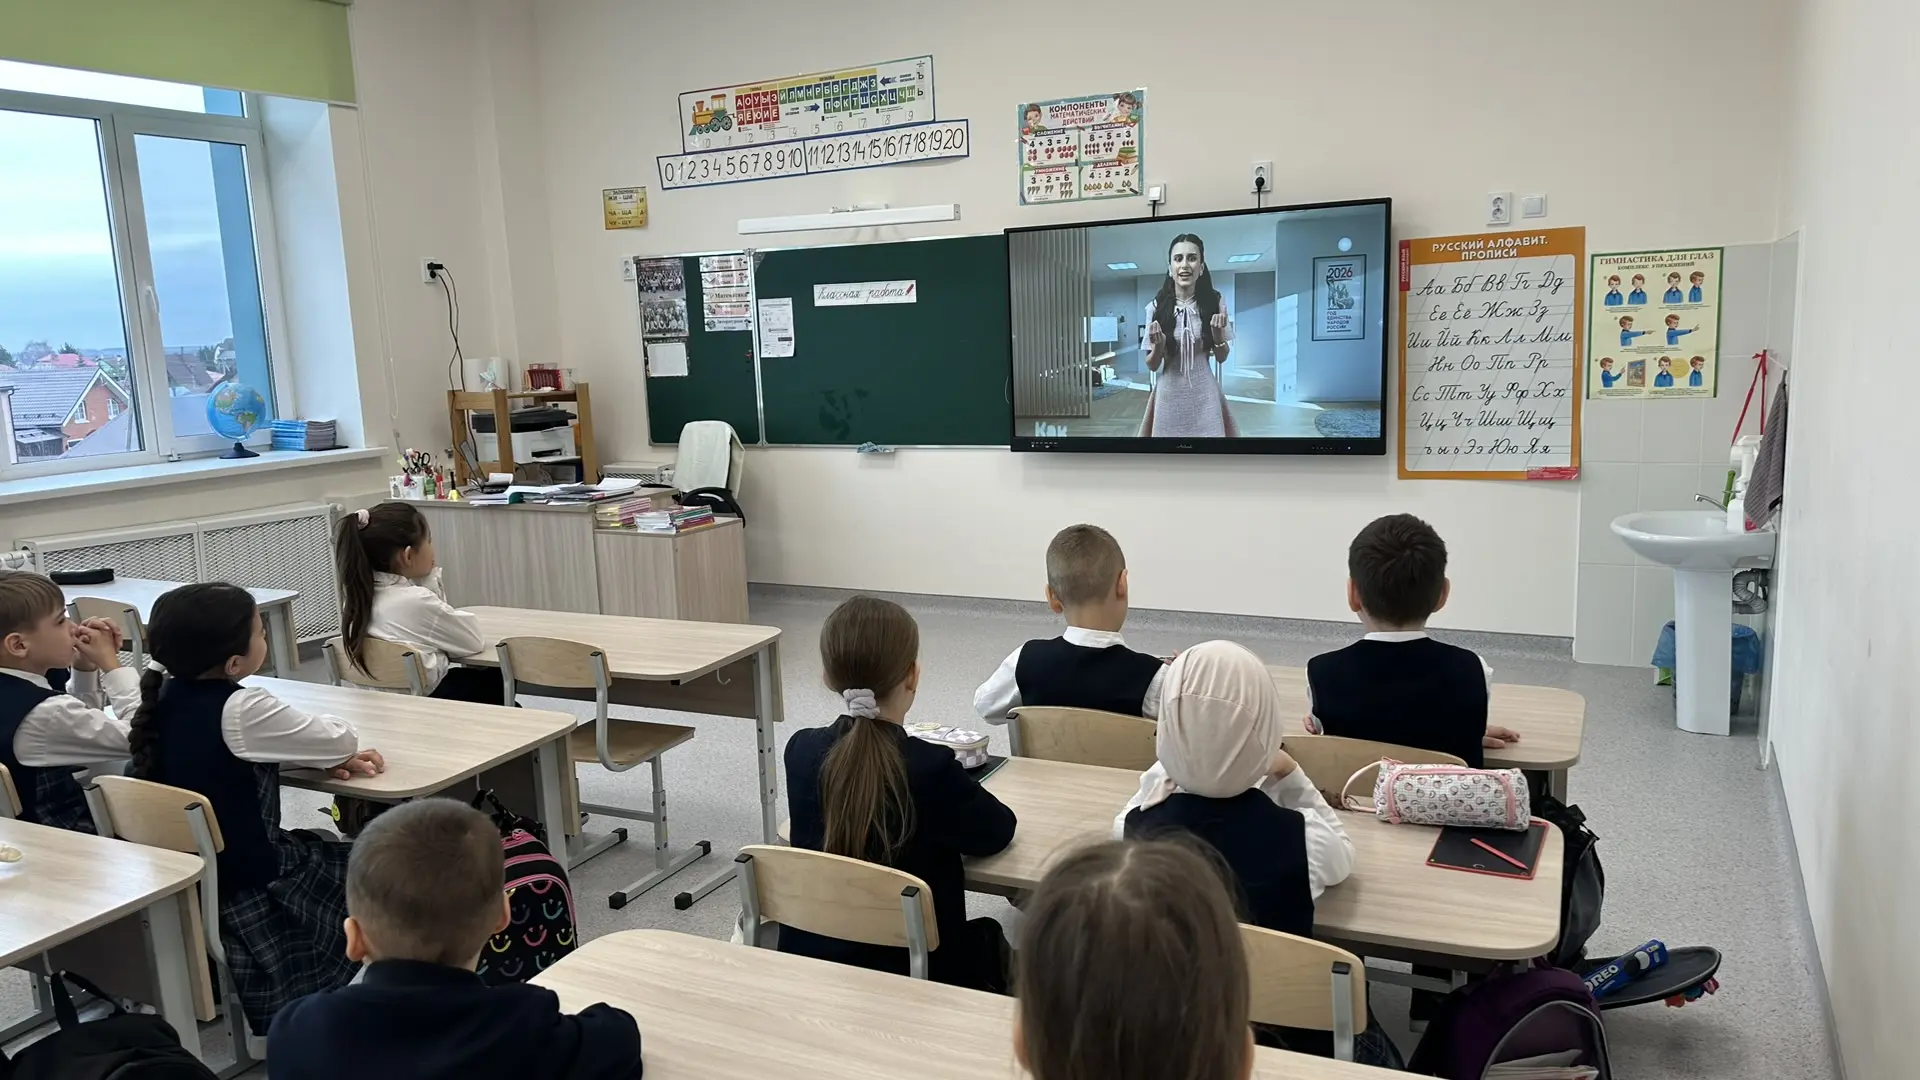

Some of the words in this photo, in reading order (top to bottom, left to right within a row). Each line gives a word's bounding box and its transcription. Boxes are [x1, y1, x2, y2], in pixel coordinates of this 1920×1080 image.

[1050, 100, 1107, 113] КОМПОНЕНТЫ
[1051, 108, 1106, 119] МАТЕМАТИЧЕСКИХ
[1062, 116, 1094, 126] ДЕЙСТВИЙ
[665, 163, 674, 181] 0
[688, 161, 696, 179] 2
[701, 160, 709, 178] 3
[713, 158, 721, 176] 4
[726, 156, 735, 176] 5
[740, 155, 748, 173] 6
[752, 153, 759, 172] 7
[764, 152, 772, 171] 8
[777, 150, 784, 169] 9
[788, 148, 802, 168] 10
[808, 146, 818, 166] 11
[821, 144, 834, 164] 12
[837, 142, 850, 163] 13
[853, 140, 865, 162] 14
[868, 138, 881, 159] 15
[883, 136, 896, 157] 16
[898, 134, 912, 155] 17
[914, 132, 925, 153] 18
[929, 130, 941, 151] 19
[943, 128, 963, 149] 20
[1432, 239, 1484, 252] РУССКИЙ
[1488, 236, 1548, 247] АЛФАВИТ.
[1462, 249, 1517, 260] ПРОПИСИ
[1600, 254, 1664, 265] ГИМНАСТИКА
[1666, 254, 1687, 262] ДЛЯ
[1690, 252, 1714, 260] ГЛАЗ
[1328, 267, 1352, 279] 2026
[1416, 279, 1446, 295] Аа
[1451, 275, 1484, 293] Бб
[1481, 273, 1507, 292] Вв
[1510, 272, 1530, 290] Гг
[1538, 271, 1564, 295] Дд
[818, 287, 860, 300] Классная
[866, 283, 904, 303] работа
[1429, 305, 1447, 321] Ее
[1453, 302, 1471, 320] Ёё
[1478, 301, 1524, 318] Жж
[1528, 299, 1549, 323] Зз
[1408, 332, 1431, 348] Ии
[1437, 328, 1462, 347] Йй
[1467, 330, 1490, 345] Кк
[1494, 328, 1525, 343] Лл
[1530, 326, 1572, 342] Мм
[1428, 356, 1454, 371] Нн
[1461, 355, 1480, 370] Оо
[1486, 354, 1516, 370] Пп
[1524, 352, 1549, 374] Рр
[1412, 386, 1429, 401] Сс
[1435, 385, 1472, 401] Тт
[1477, 384, 1496, 406] Уу
[1501, 382, 1529, 405] Фф
[1533, 382, 1565, 398] Хх
[1420, 412, 1447, 431] Цц
[1452, 412, 1473, 427] Чч
[1478, 410, 1512, 426] Шш
[1517, 410, 1556, 430] Щщ
[1035, 422, 1067, 437] Как
[1464, 439, 1483, 454] Ээ
[1488, 438, 1518, 454] Юю
[1524, 438, 1551, 454] Яя
